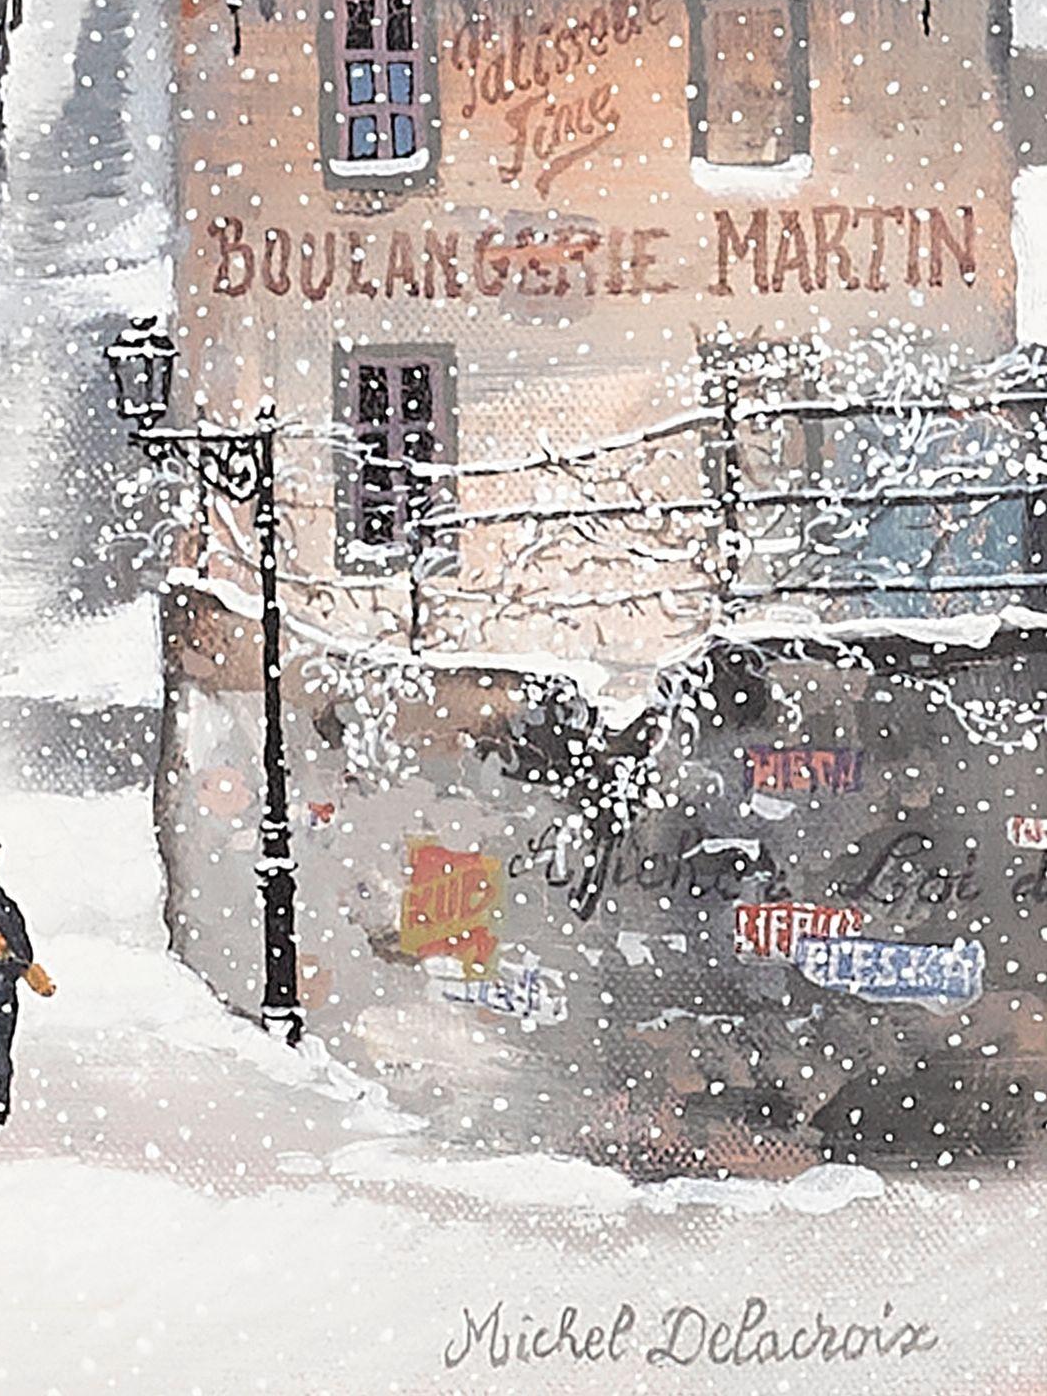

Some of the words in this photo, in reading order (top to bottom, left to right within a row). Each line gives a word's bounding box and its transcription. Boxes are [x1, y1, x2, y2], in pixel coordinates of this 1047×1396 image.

[207, 216, 679, 302] BOULANGERIE
[708, 205, 976, 297] MARTIN
[444, 1300, 636, 1368] Michel
[645, 1297, 940, 1366] Delacroix
